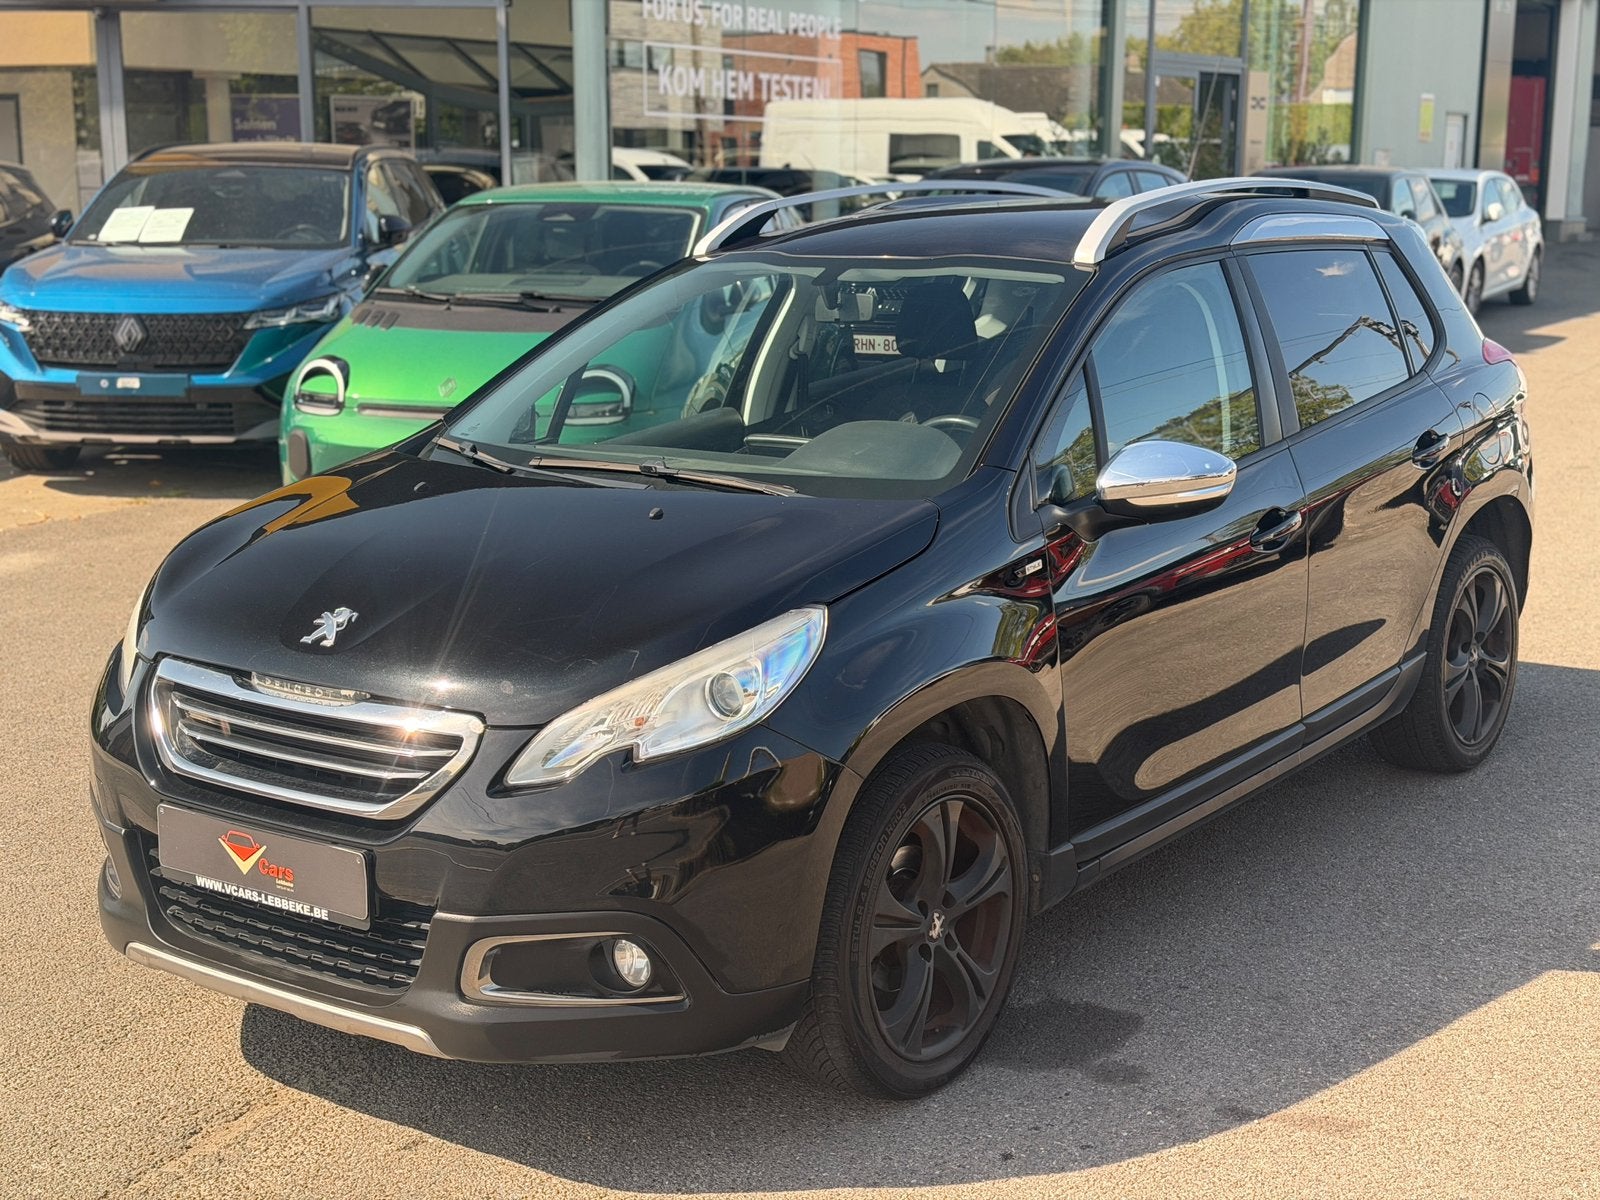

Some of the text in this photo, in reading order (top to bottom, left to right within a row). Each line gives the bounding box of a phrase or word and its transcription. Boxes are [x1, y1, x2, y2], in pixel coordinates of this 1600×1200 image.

[642, 0, 677, 21] FOR
[712, 2, 743, 30] FOR
[746, 6, 785, 34] REAL
[789, 11, 841, 40] PEOPLE
[658, 65, 831, 101] KOM HEM TESTEN!
[258, 857, 294, 881] Cars
[195, 875, 329, 920] WWW.VCARS-LEBBEKE.BE
